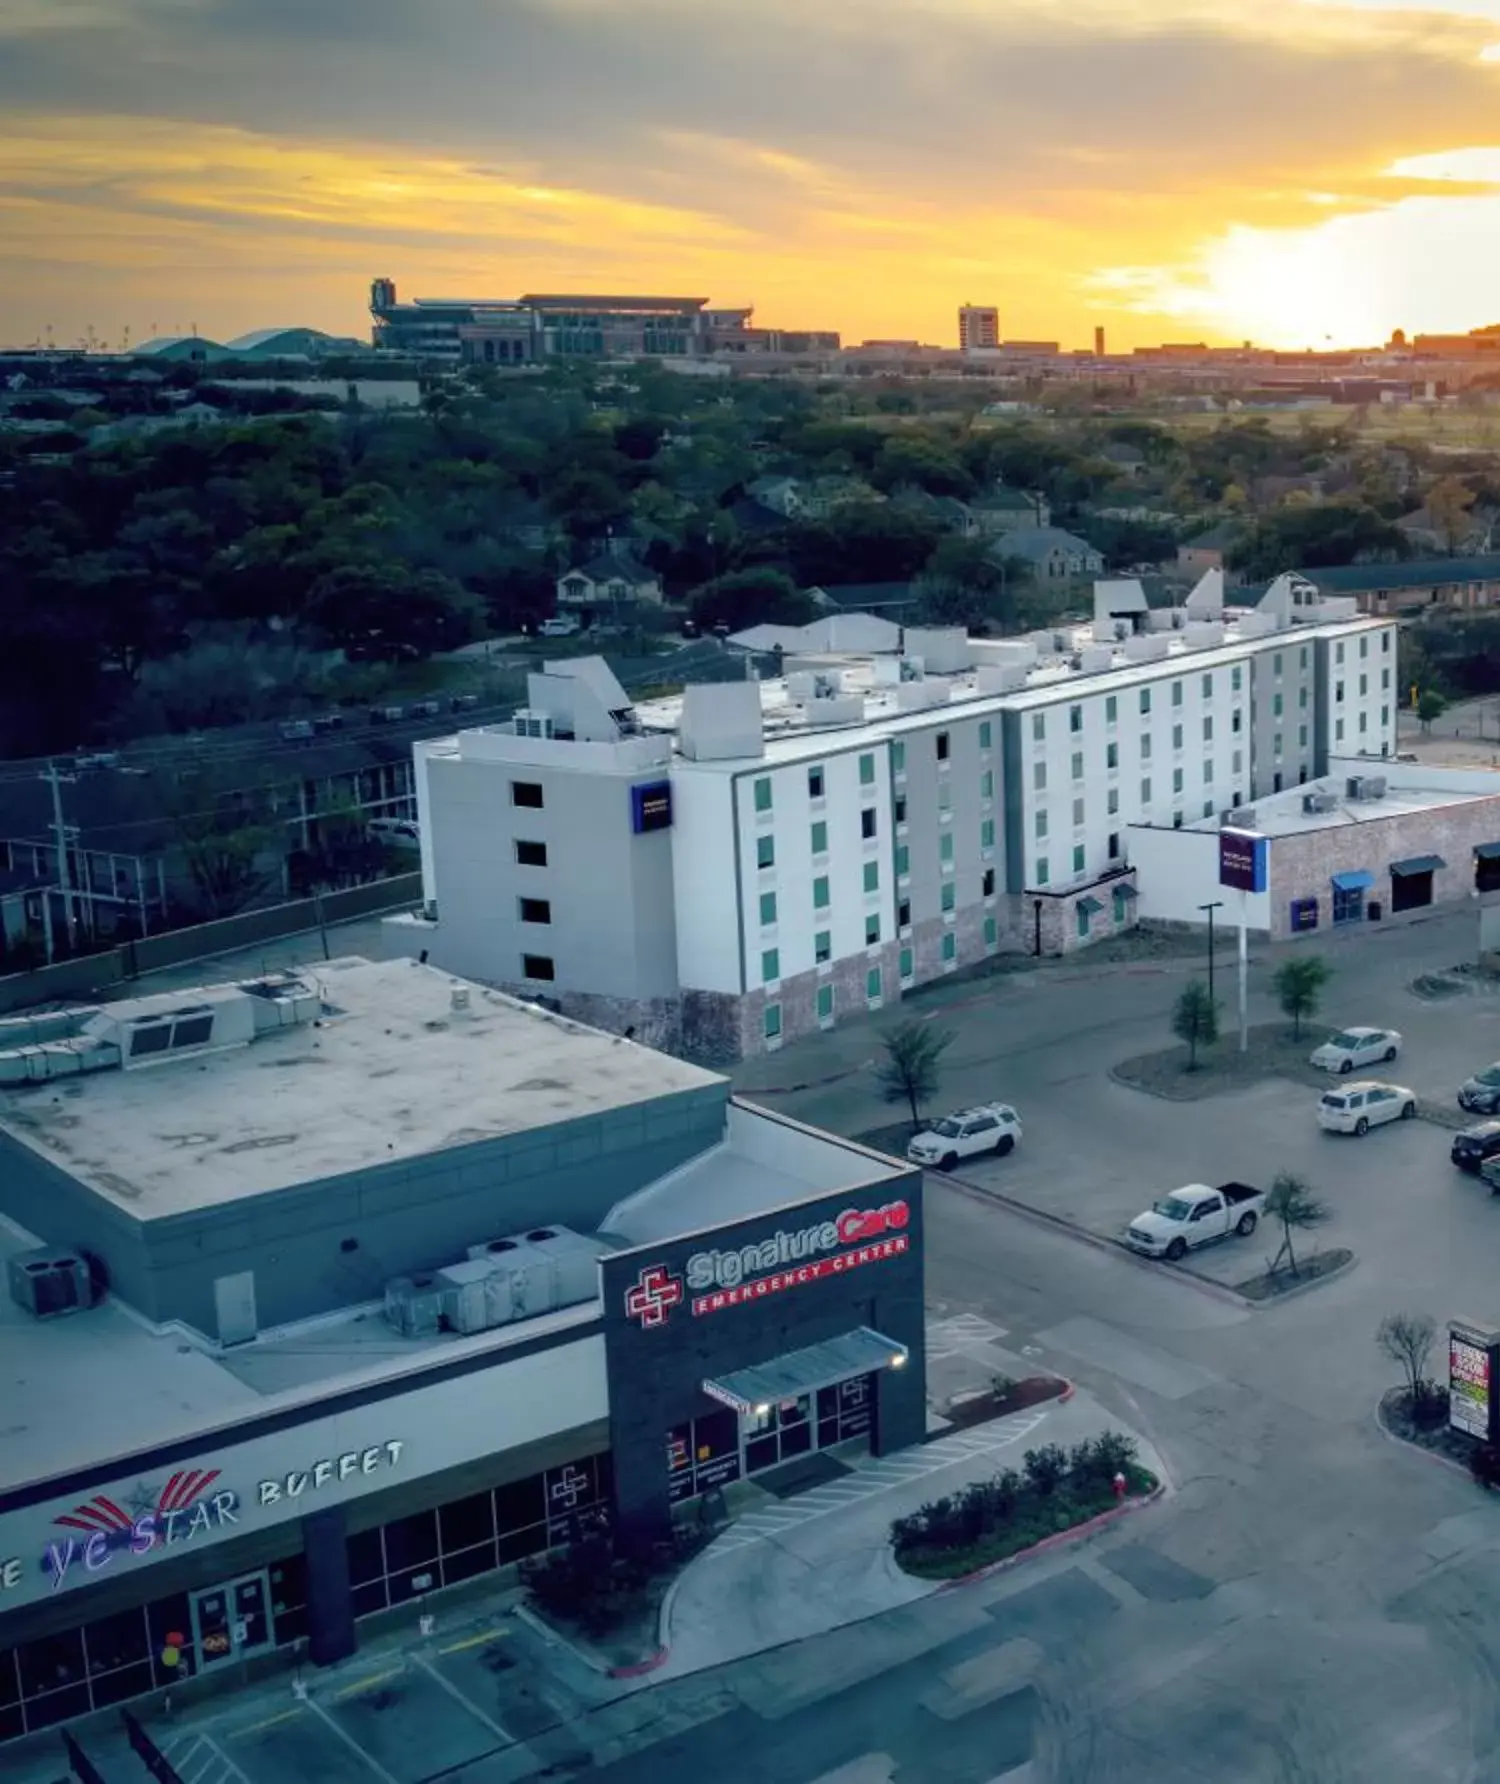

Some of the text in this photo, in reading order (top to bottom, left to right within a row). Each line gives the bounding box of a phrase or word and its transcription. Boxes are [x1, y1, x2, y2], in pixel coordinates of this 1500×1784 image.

[698, 1238, 906, 1312] EMERGENCY CENTER
[128, 1491, 239, 1554] STAR
[259, 1440, 403, 1507] BUFFET
